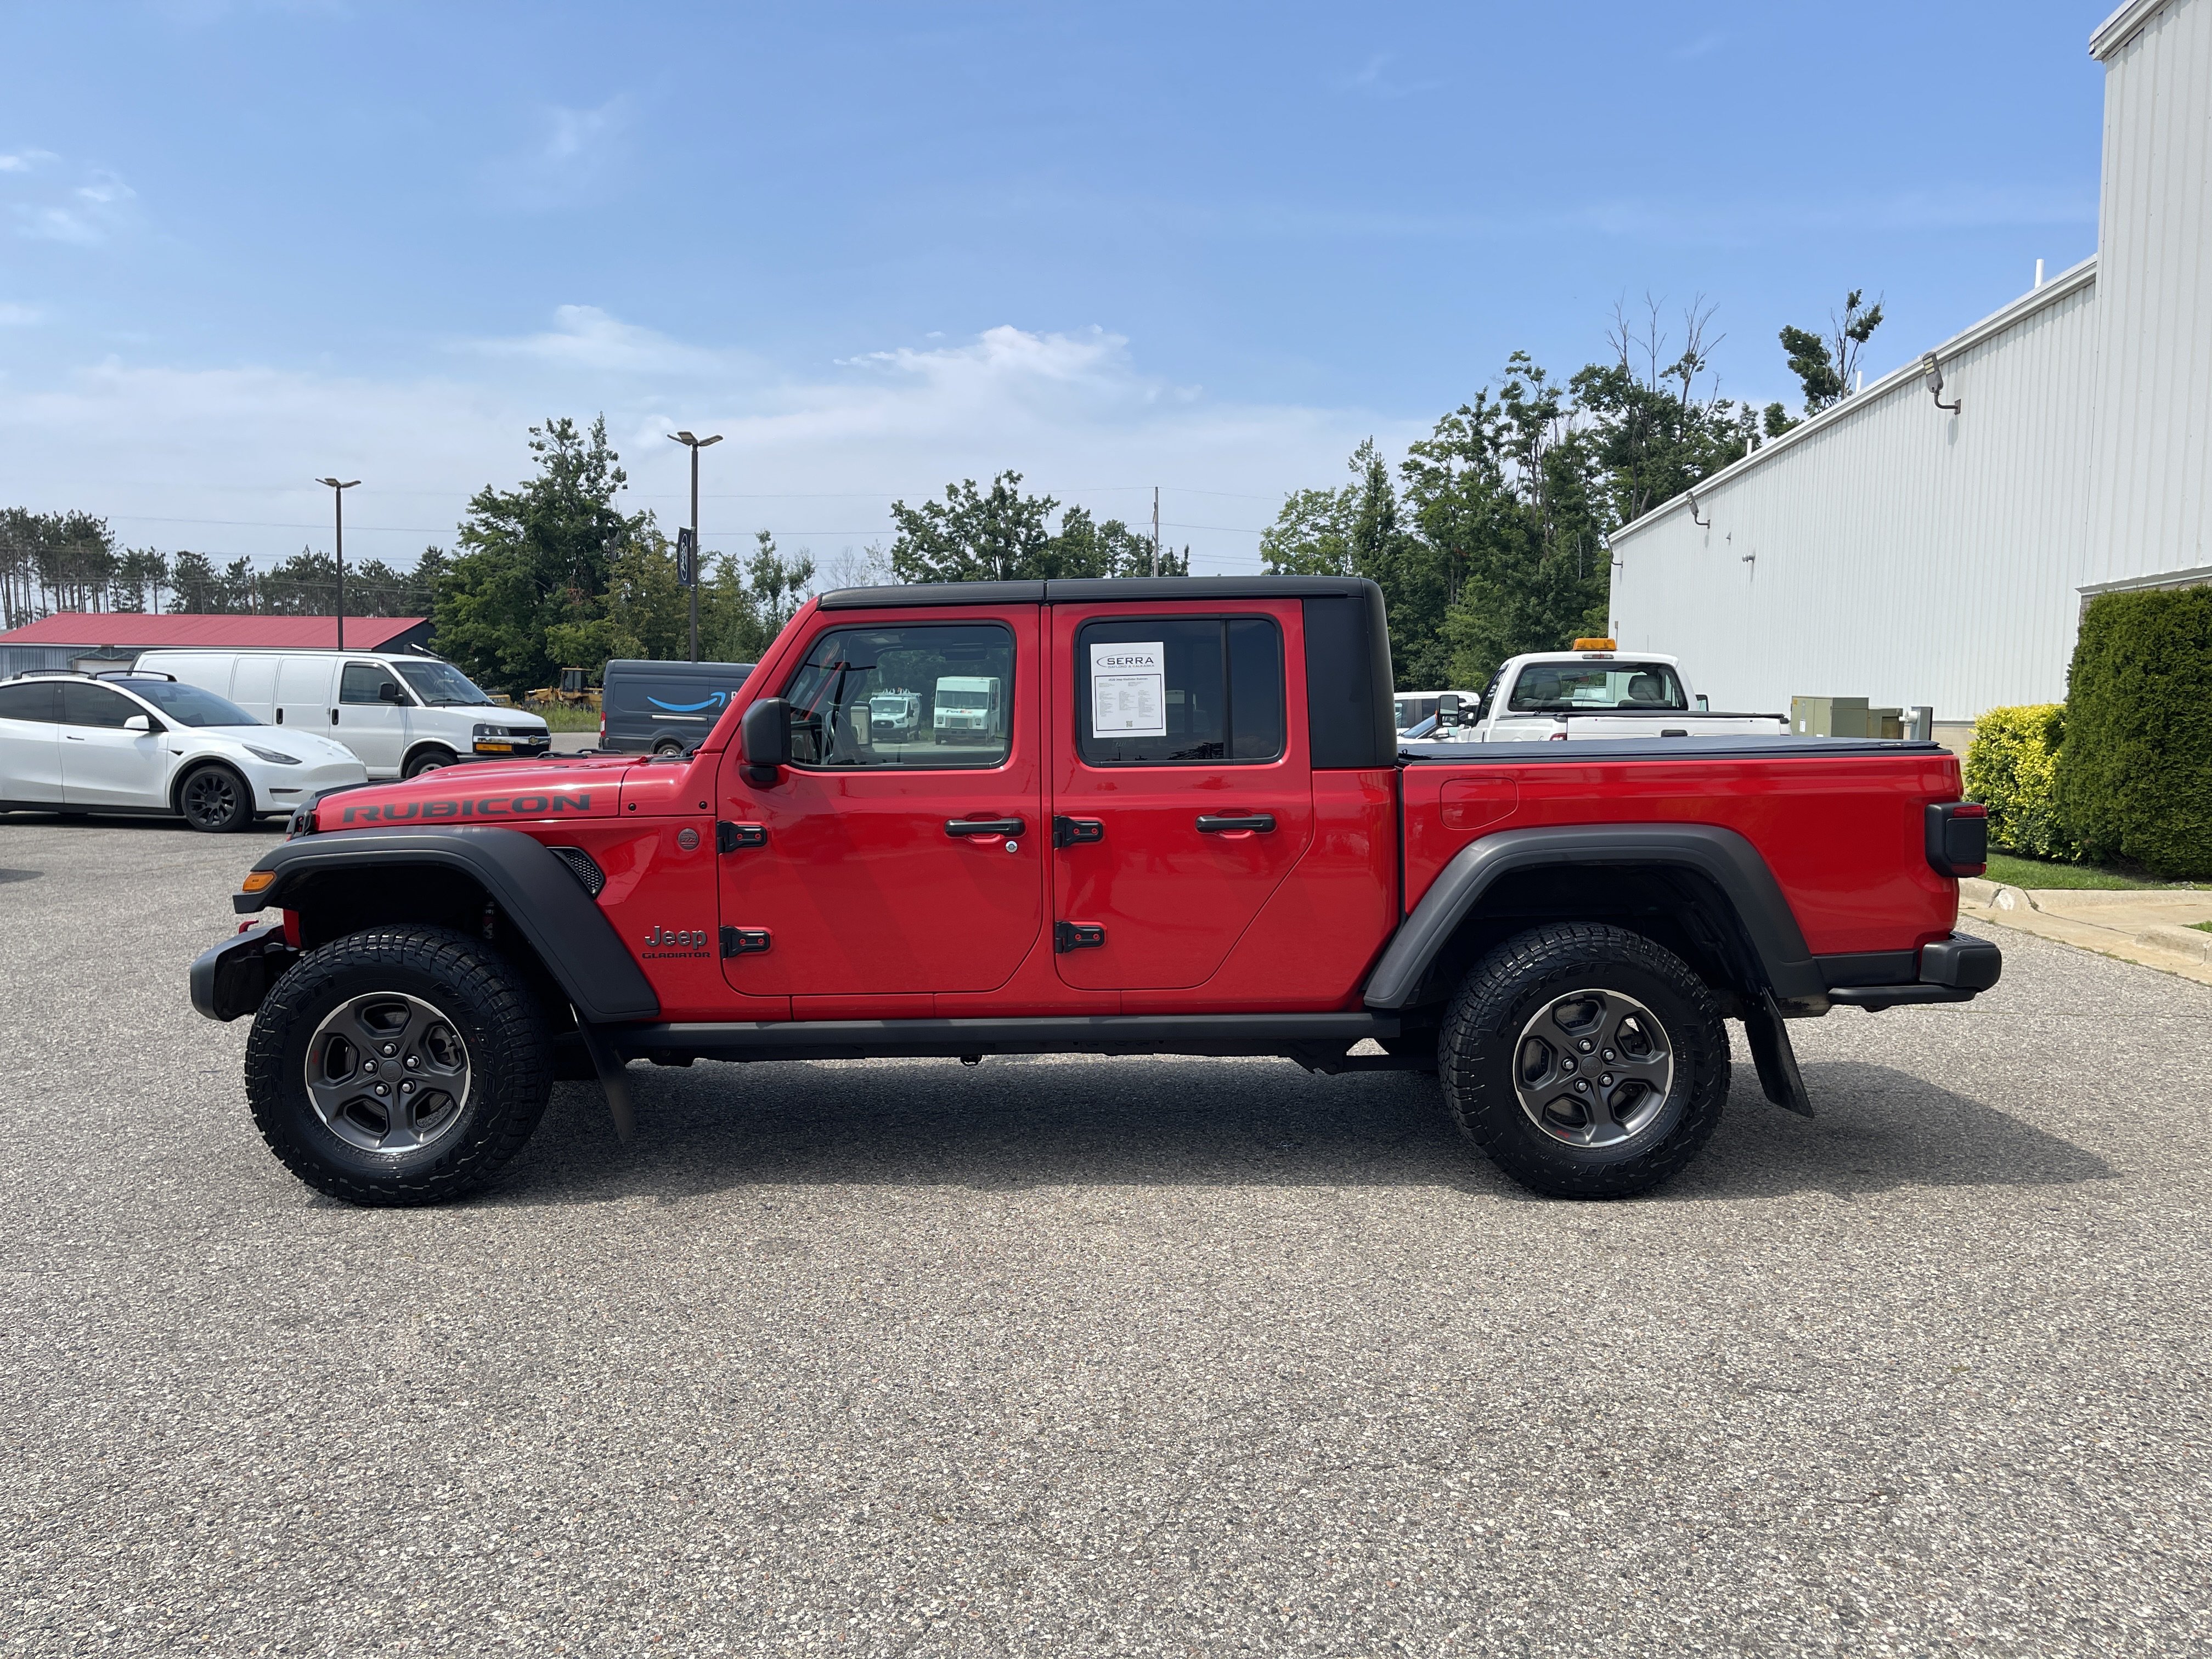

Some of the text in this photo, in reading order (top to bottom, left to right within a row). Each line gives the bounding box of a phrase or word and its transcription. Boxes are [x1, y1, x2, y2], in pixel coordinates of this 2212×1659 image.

[1107, 657, 1154, 665] SERRA
[342, 794, 591, 823] RUBICON
[645, 926, 707, 950] Jeep
